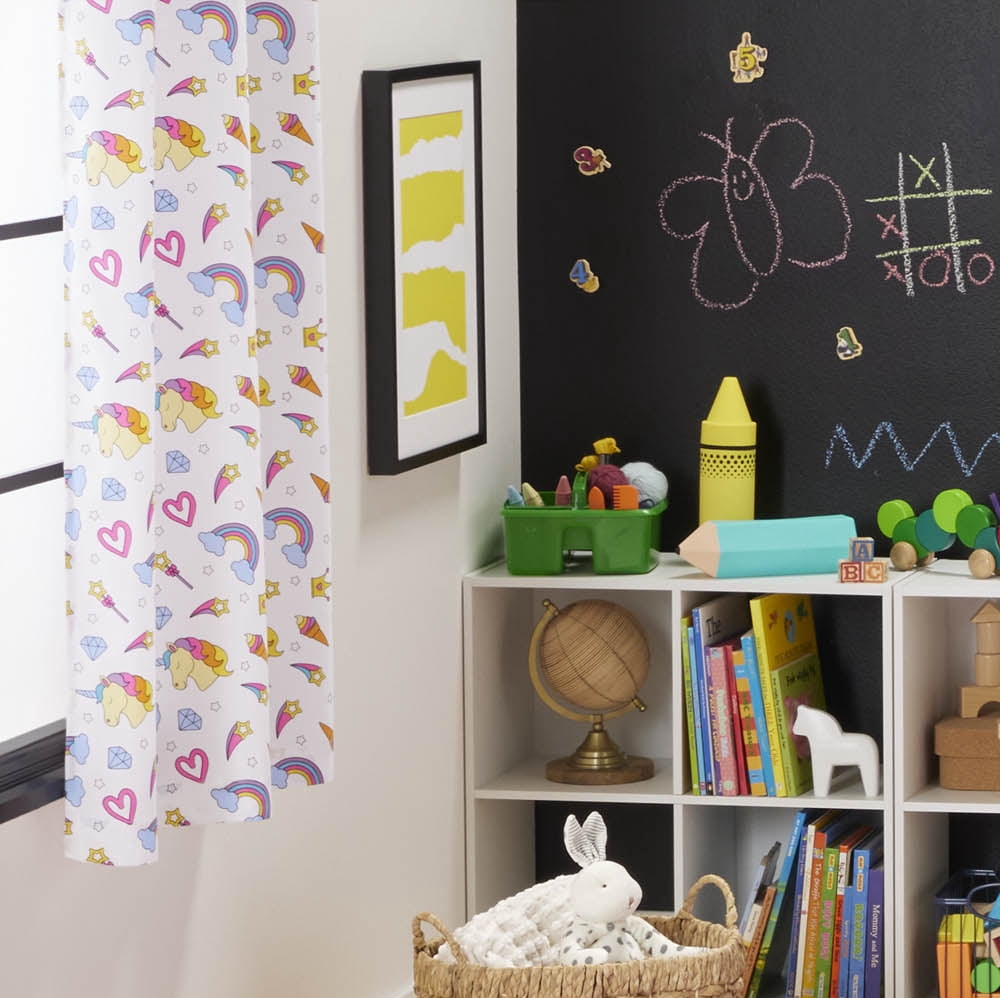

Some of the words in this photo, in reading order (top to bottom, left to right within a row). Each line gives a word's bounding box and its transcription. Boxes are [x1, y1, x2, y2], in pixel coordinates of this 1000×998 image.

[813, 862, 823, 876] The
[871, 903, 882, 938] Mommy
[870, 938, 878, 953] and
[870, 953, 880, 969] Me
